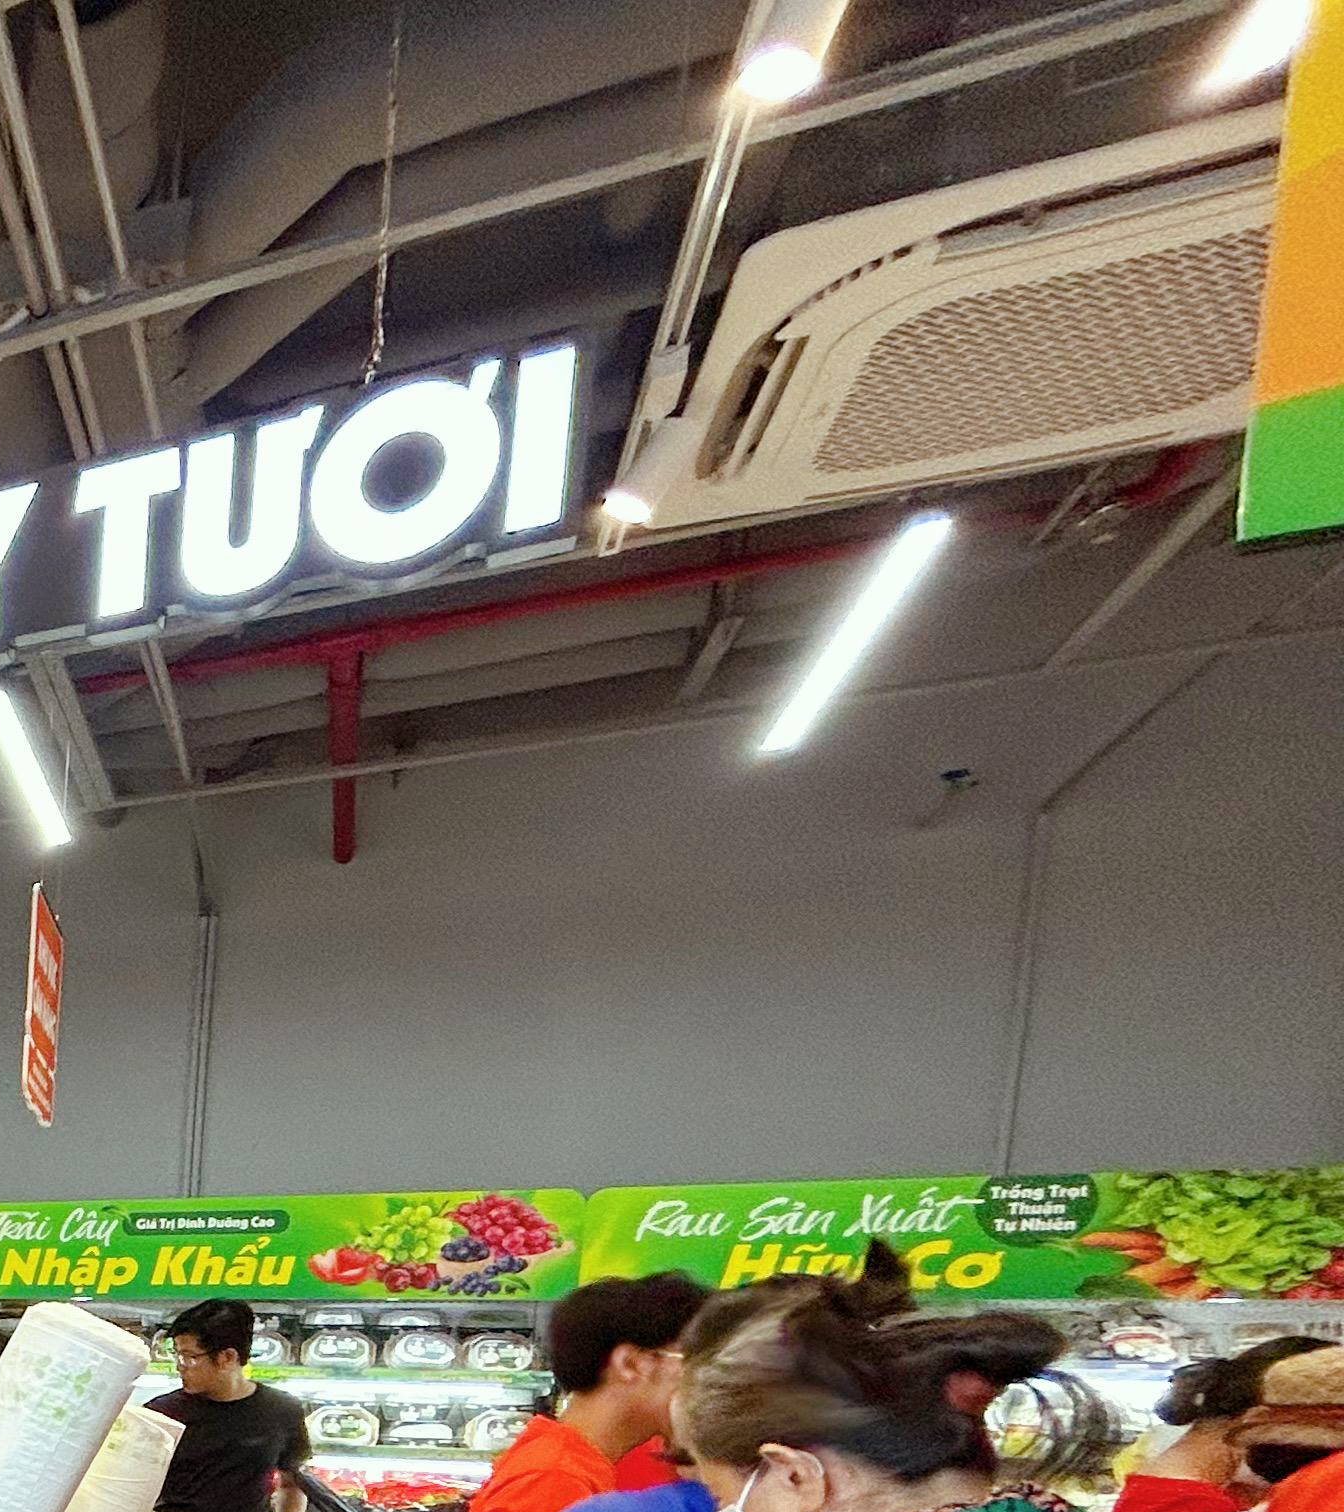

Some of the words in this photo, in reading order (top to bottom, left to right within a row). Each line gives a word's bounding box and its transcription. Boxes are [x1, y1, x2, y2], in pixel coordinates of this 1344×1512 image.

[73, 344, 579, 620] TƯƠI
[59, 1208, 119, 1246] Cây
[250, 1216, 275, 1228] Cao
[635, 1200, 731, 1241] Rau
[737, 1197, 832, 1241] Sản
[843, 1187, 986, 1239] Xuất
[0, 1246, 139, 1295] Nhập
[150, 1235, 296, 1286] Khẩu
[909, 1239, 1005, 1289] Cơ
